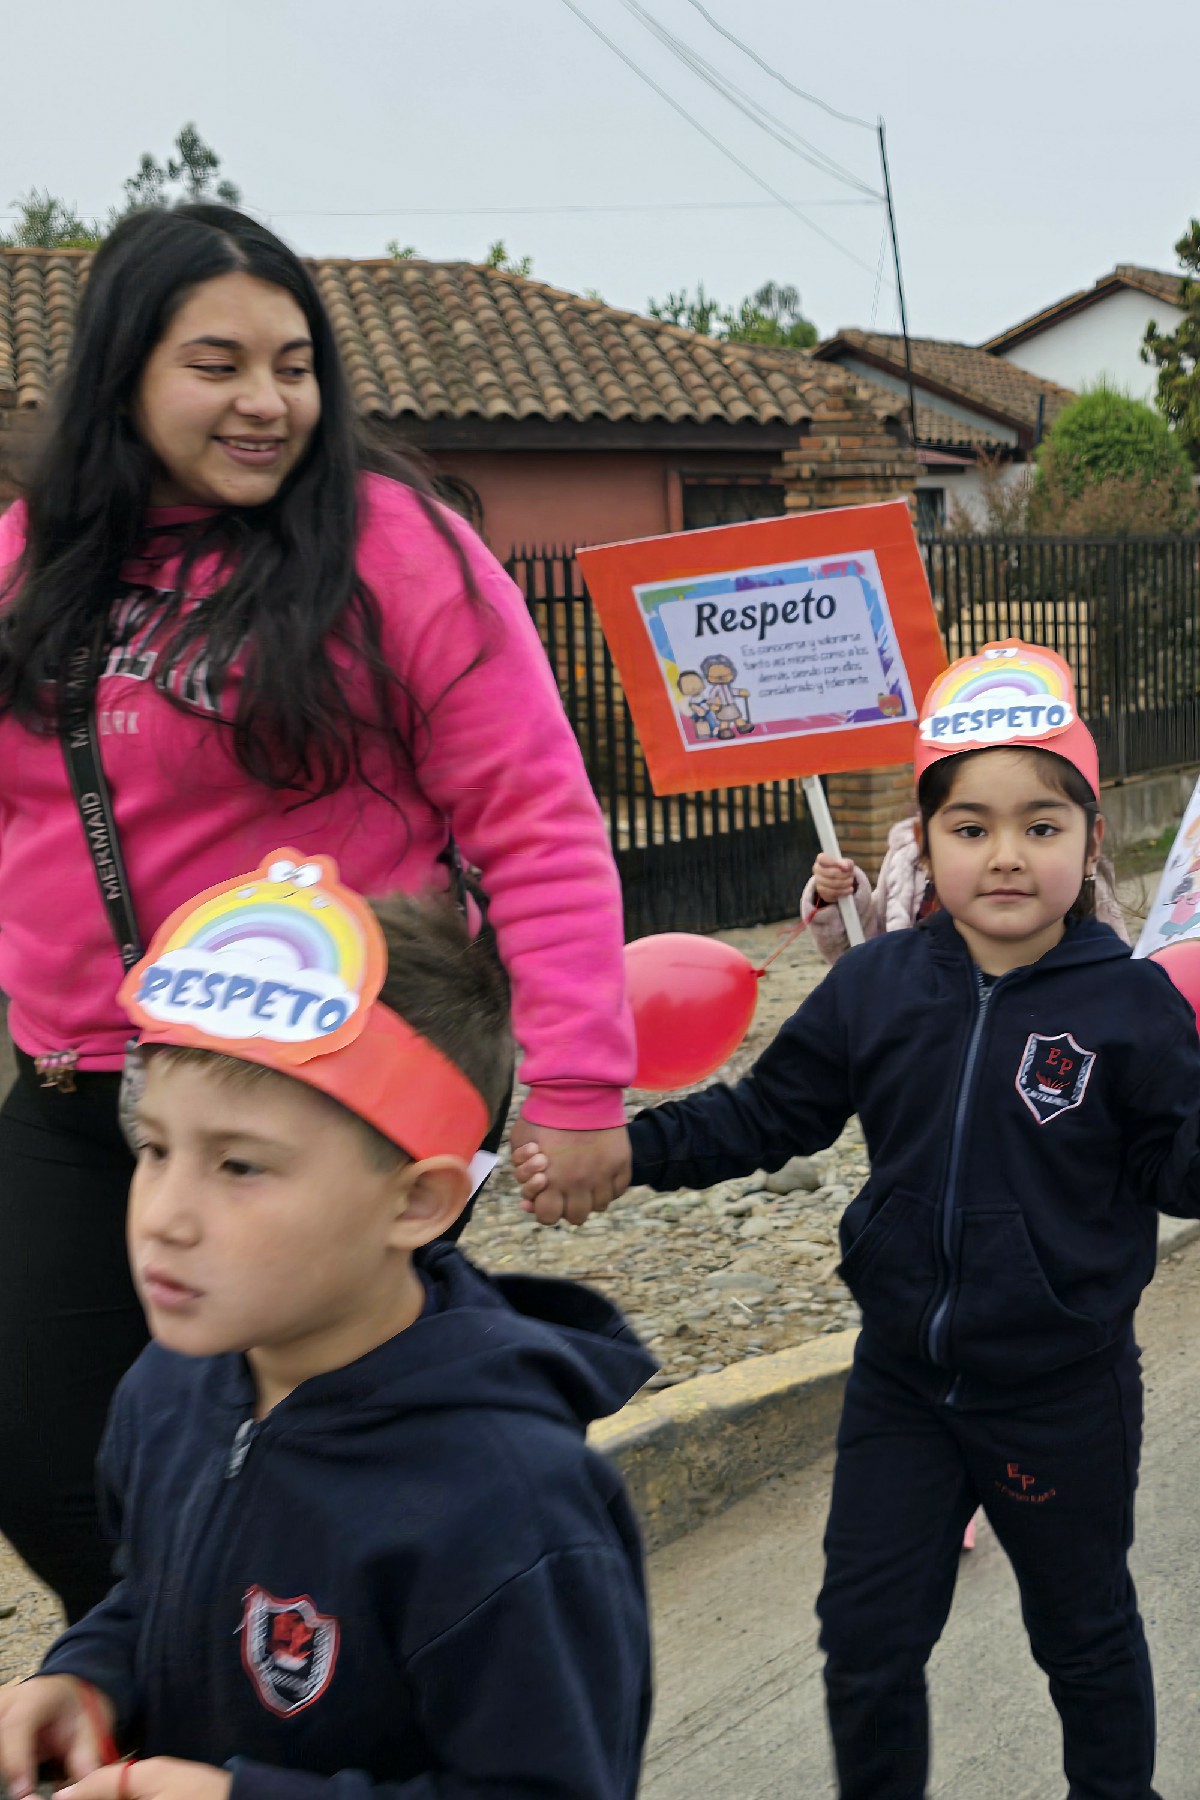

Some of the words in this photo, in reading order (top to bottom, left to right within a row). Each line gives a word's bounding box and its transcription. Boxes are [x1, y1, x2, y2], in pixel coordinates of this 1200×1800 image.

[694, 587, 837, 641] Respeto
[930, 704, 1066, 738] RESPETO
[79, 792, 122, 900] MERMAID
[136, 966, 348, 1033] RESPETO
